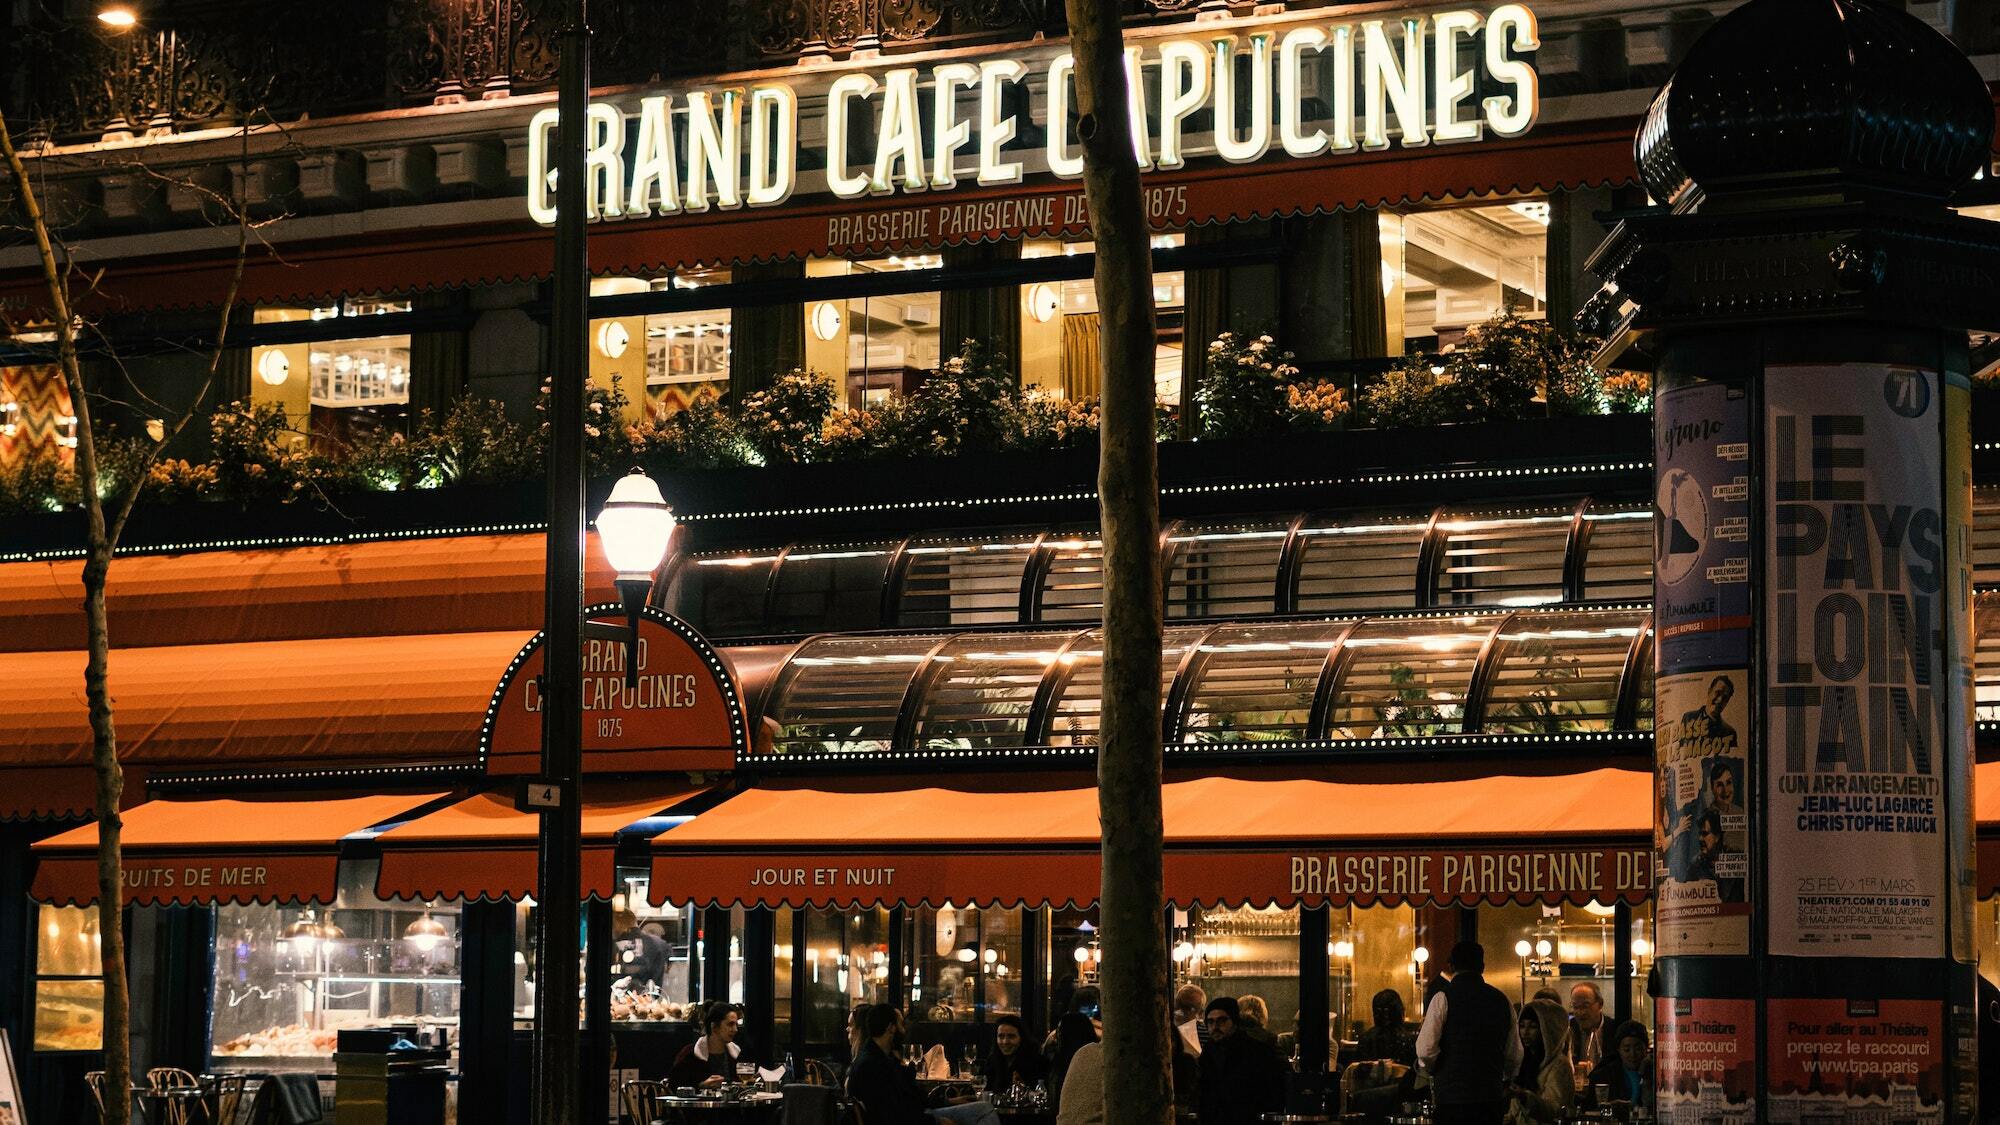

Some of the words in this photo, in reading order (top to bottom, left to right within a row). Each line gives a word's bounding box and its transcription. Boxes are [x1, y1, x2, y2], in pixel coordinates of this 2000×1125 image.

[527, 82, 796, 227] GRAND
[827, 58, 1030, 198] CAFE
[827, 207, 929, 247] BRASSERIE
[938, 197, 1057, 237] PARISIENNE
[1144, 186, 1187, 218] 1875
[1776, 415, 1864, 501] LE
[1776, 503, 1942, 593] PAYS
[1777, 593, 1931, 684] LOIN
[582, 674, 696, 710] CAPUCINES
[597, 718, 622, 737] 1875
[1769, 685, 1932, 774] TAIN
[542, 789, 552, 801] 4
[1779, 775, 1809, 794] (UN
[1813, 775, 1939, 796] ARRANGEMENT)
[1798, 796, 1872, 813] JEAN-LUC
[1876, 797, 1933, 814] LAGARCE
[1797, 815, 1893, 832] CHRISTOPHE
[1897, 816, 1937, 833] RAUCK
[119, 868, 175, 887] RUITS
[184, 867, 212, 886] DE
[220, 867, 267, 885] MER
[751, 868, 805, 887] JOUR
[814, 868, 838, 886] ET
[846, 867, 895, 886] NUIT
[1291, 856, 1432, 895] BRASSERIE
[1444, 852, 1603, 893] PARISIENNE
[1798, 878, 1815, 892] 25
[1819, 876, 1845, 892] FÉV
[1859, 877, 1876, 892] 1ER
[1880, 879, 1916, 893] MARS
[1798, 897, 1874, 906] THEATRE71.COM
[1877, 897, 1887, 906] 01
[1787, 1022, 1821, 1036] Pour
[1825, 1022, 1856, 1035] aller
[1859, 1025, 1876, 1036] au
[1879, 1022, 1929, 1036] Théâtre
[1683, 1039, 1737, 1053] raccourci
[1787, 1041, 1842, 1058] prenez
[1847, 1039, 1861, 1054] le
[1864, 1040, 1930, 1055] raccourci
[1802, 1058, 1919, 1078] www.tpa.paris
